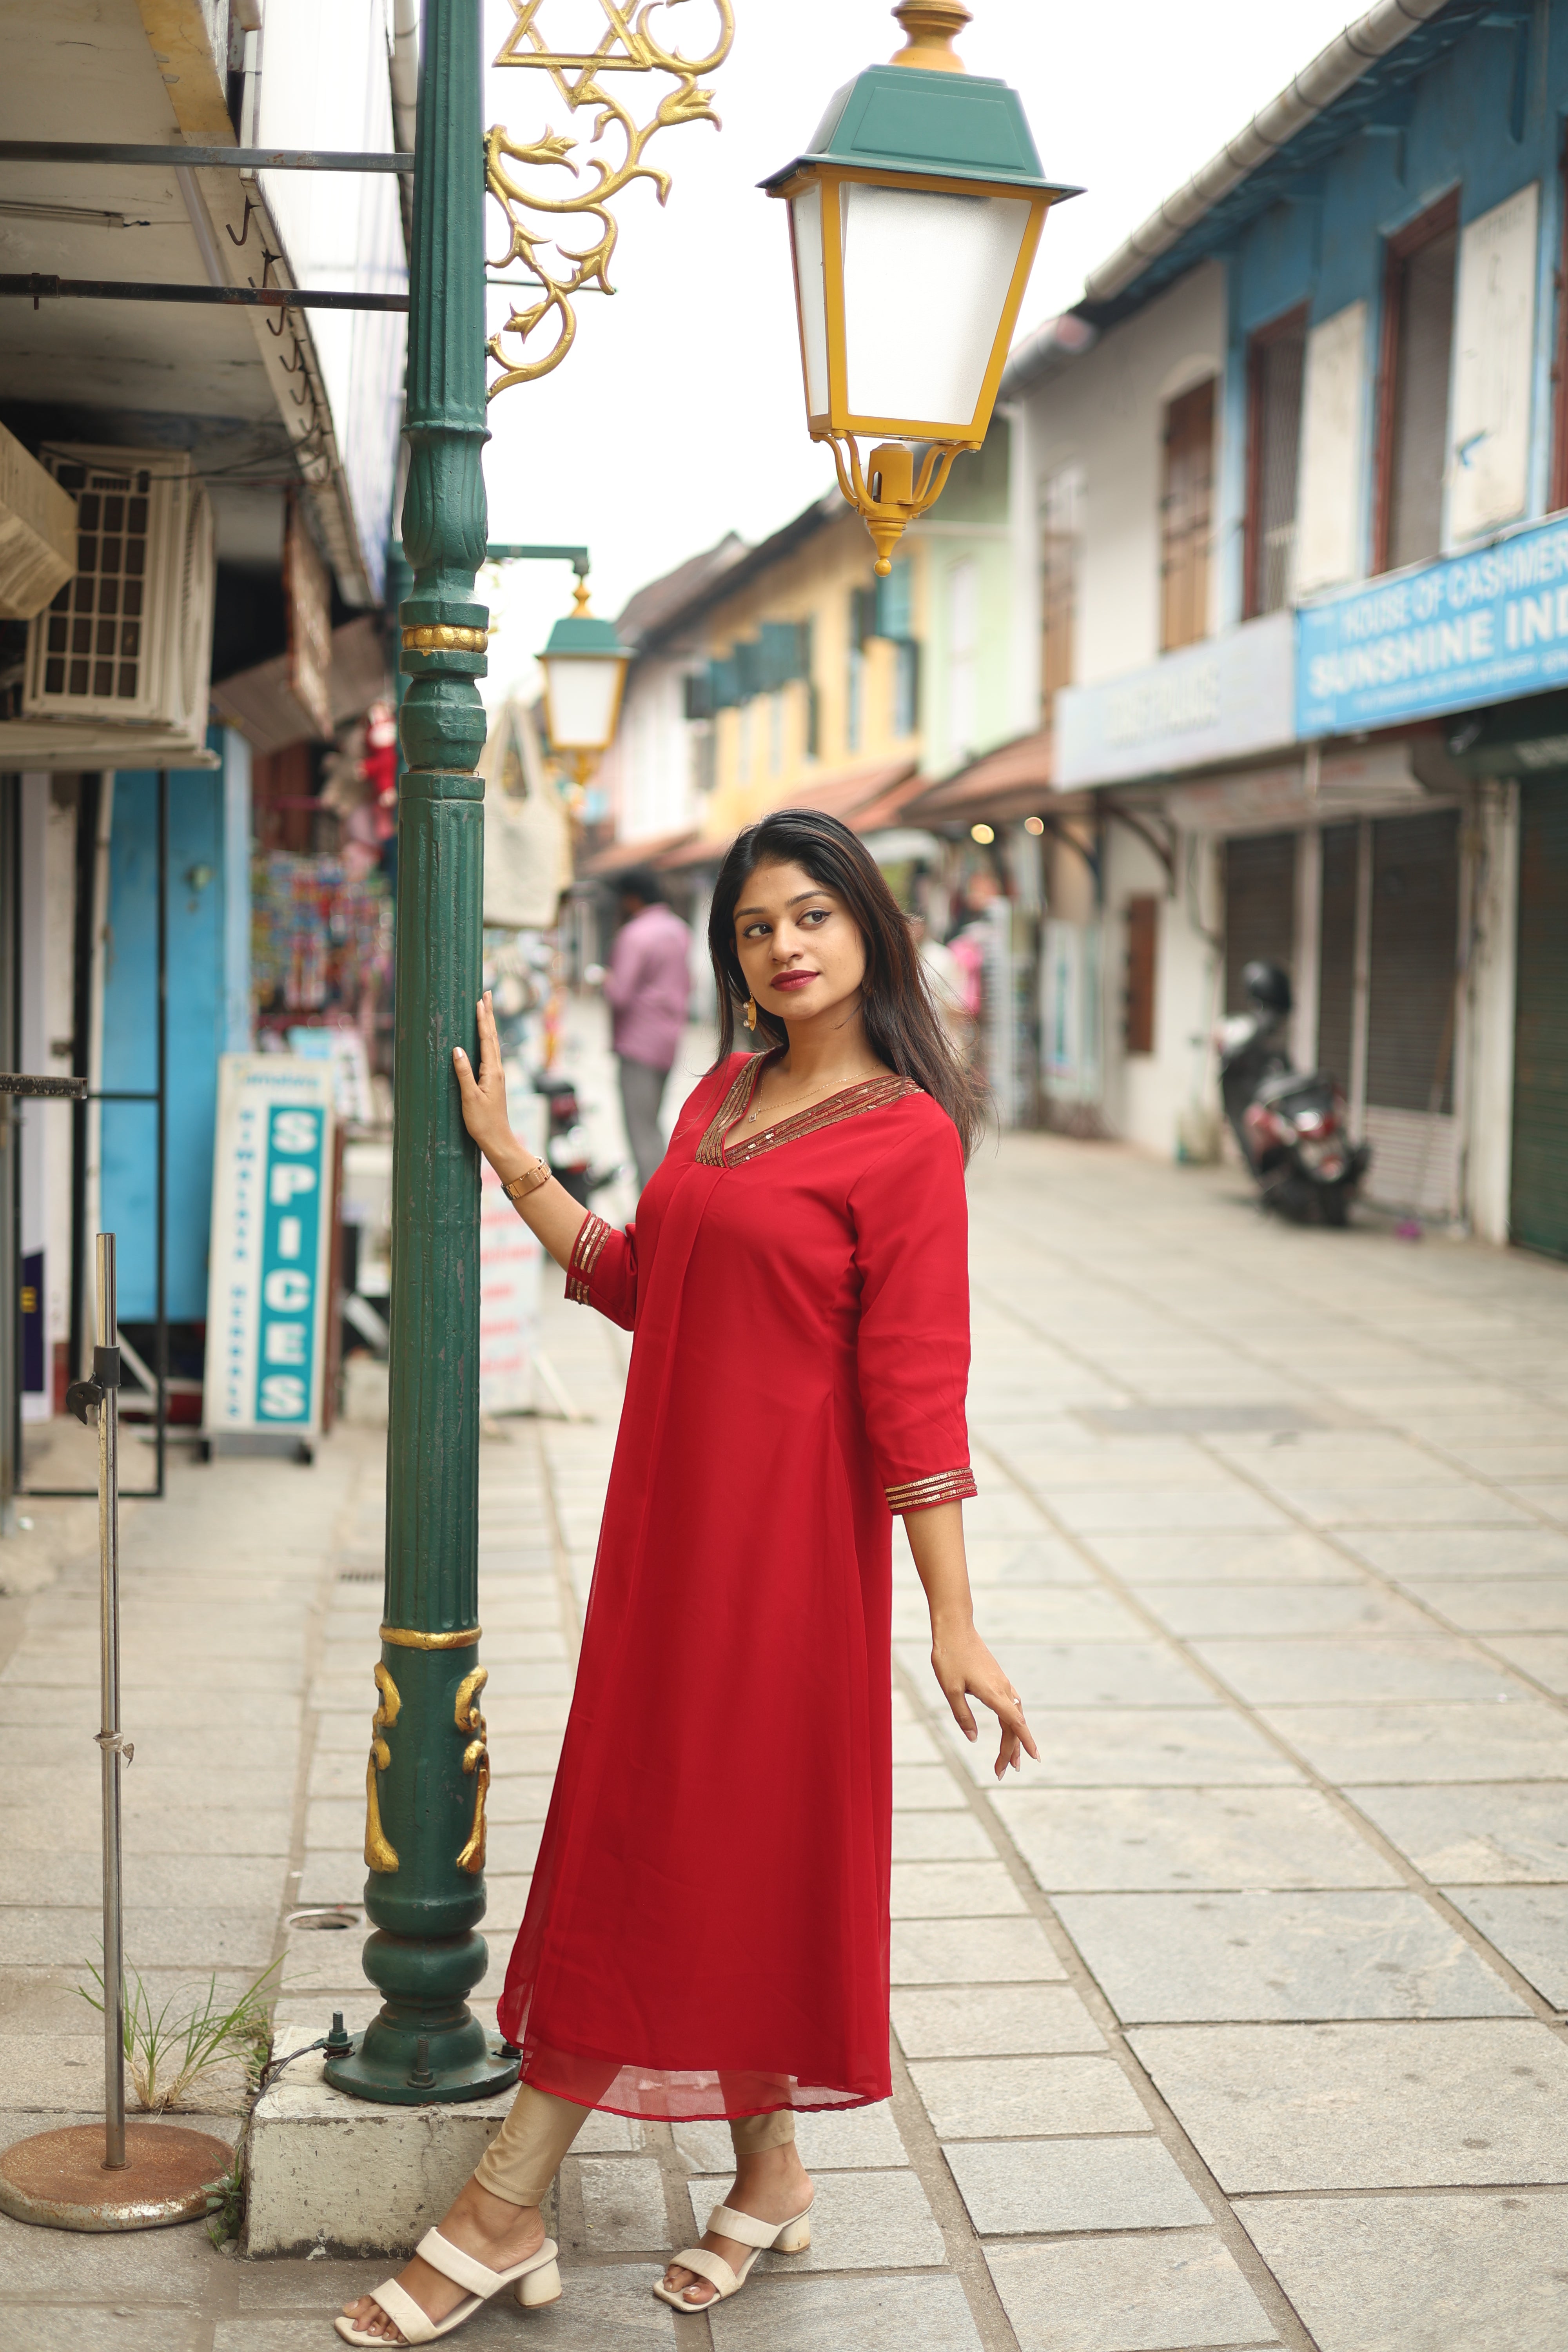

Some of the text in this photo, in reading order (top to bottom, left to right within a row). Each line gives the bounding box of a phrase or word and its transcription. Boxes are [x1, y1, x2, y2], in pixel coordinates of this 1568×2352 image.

[1341, 585, 1409, 641] HOUSE
[1414, 573, 1444, 619] OF
[1310, 608, 1493, 697] SUNSHINE
[260, 1111, 317, 1419] SPICES
